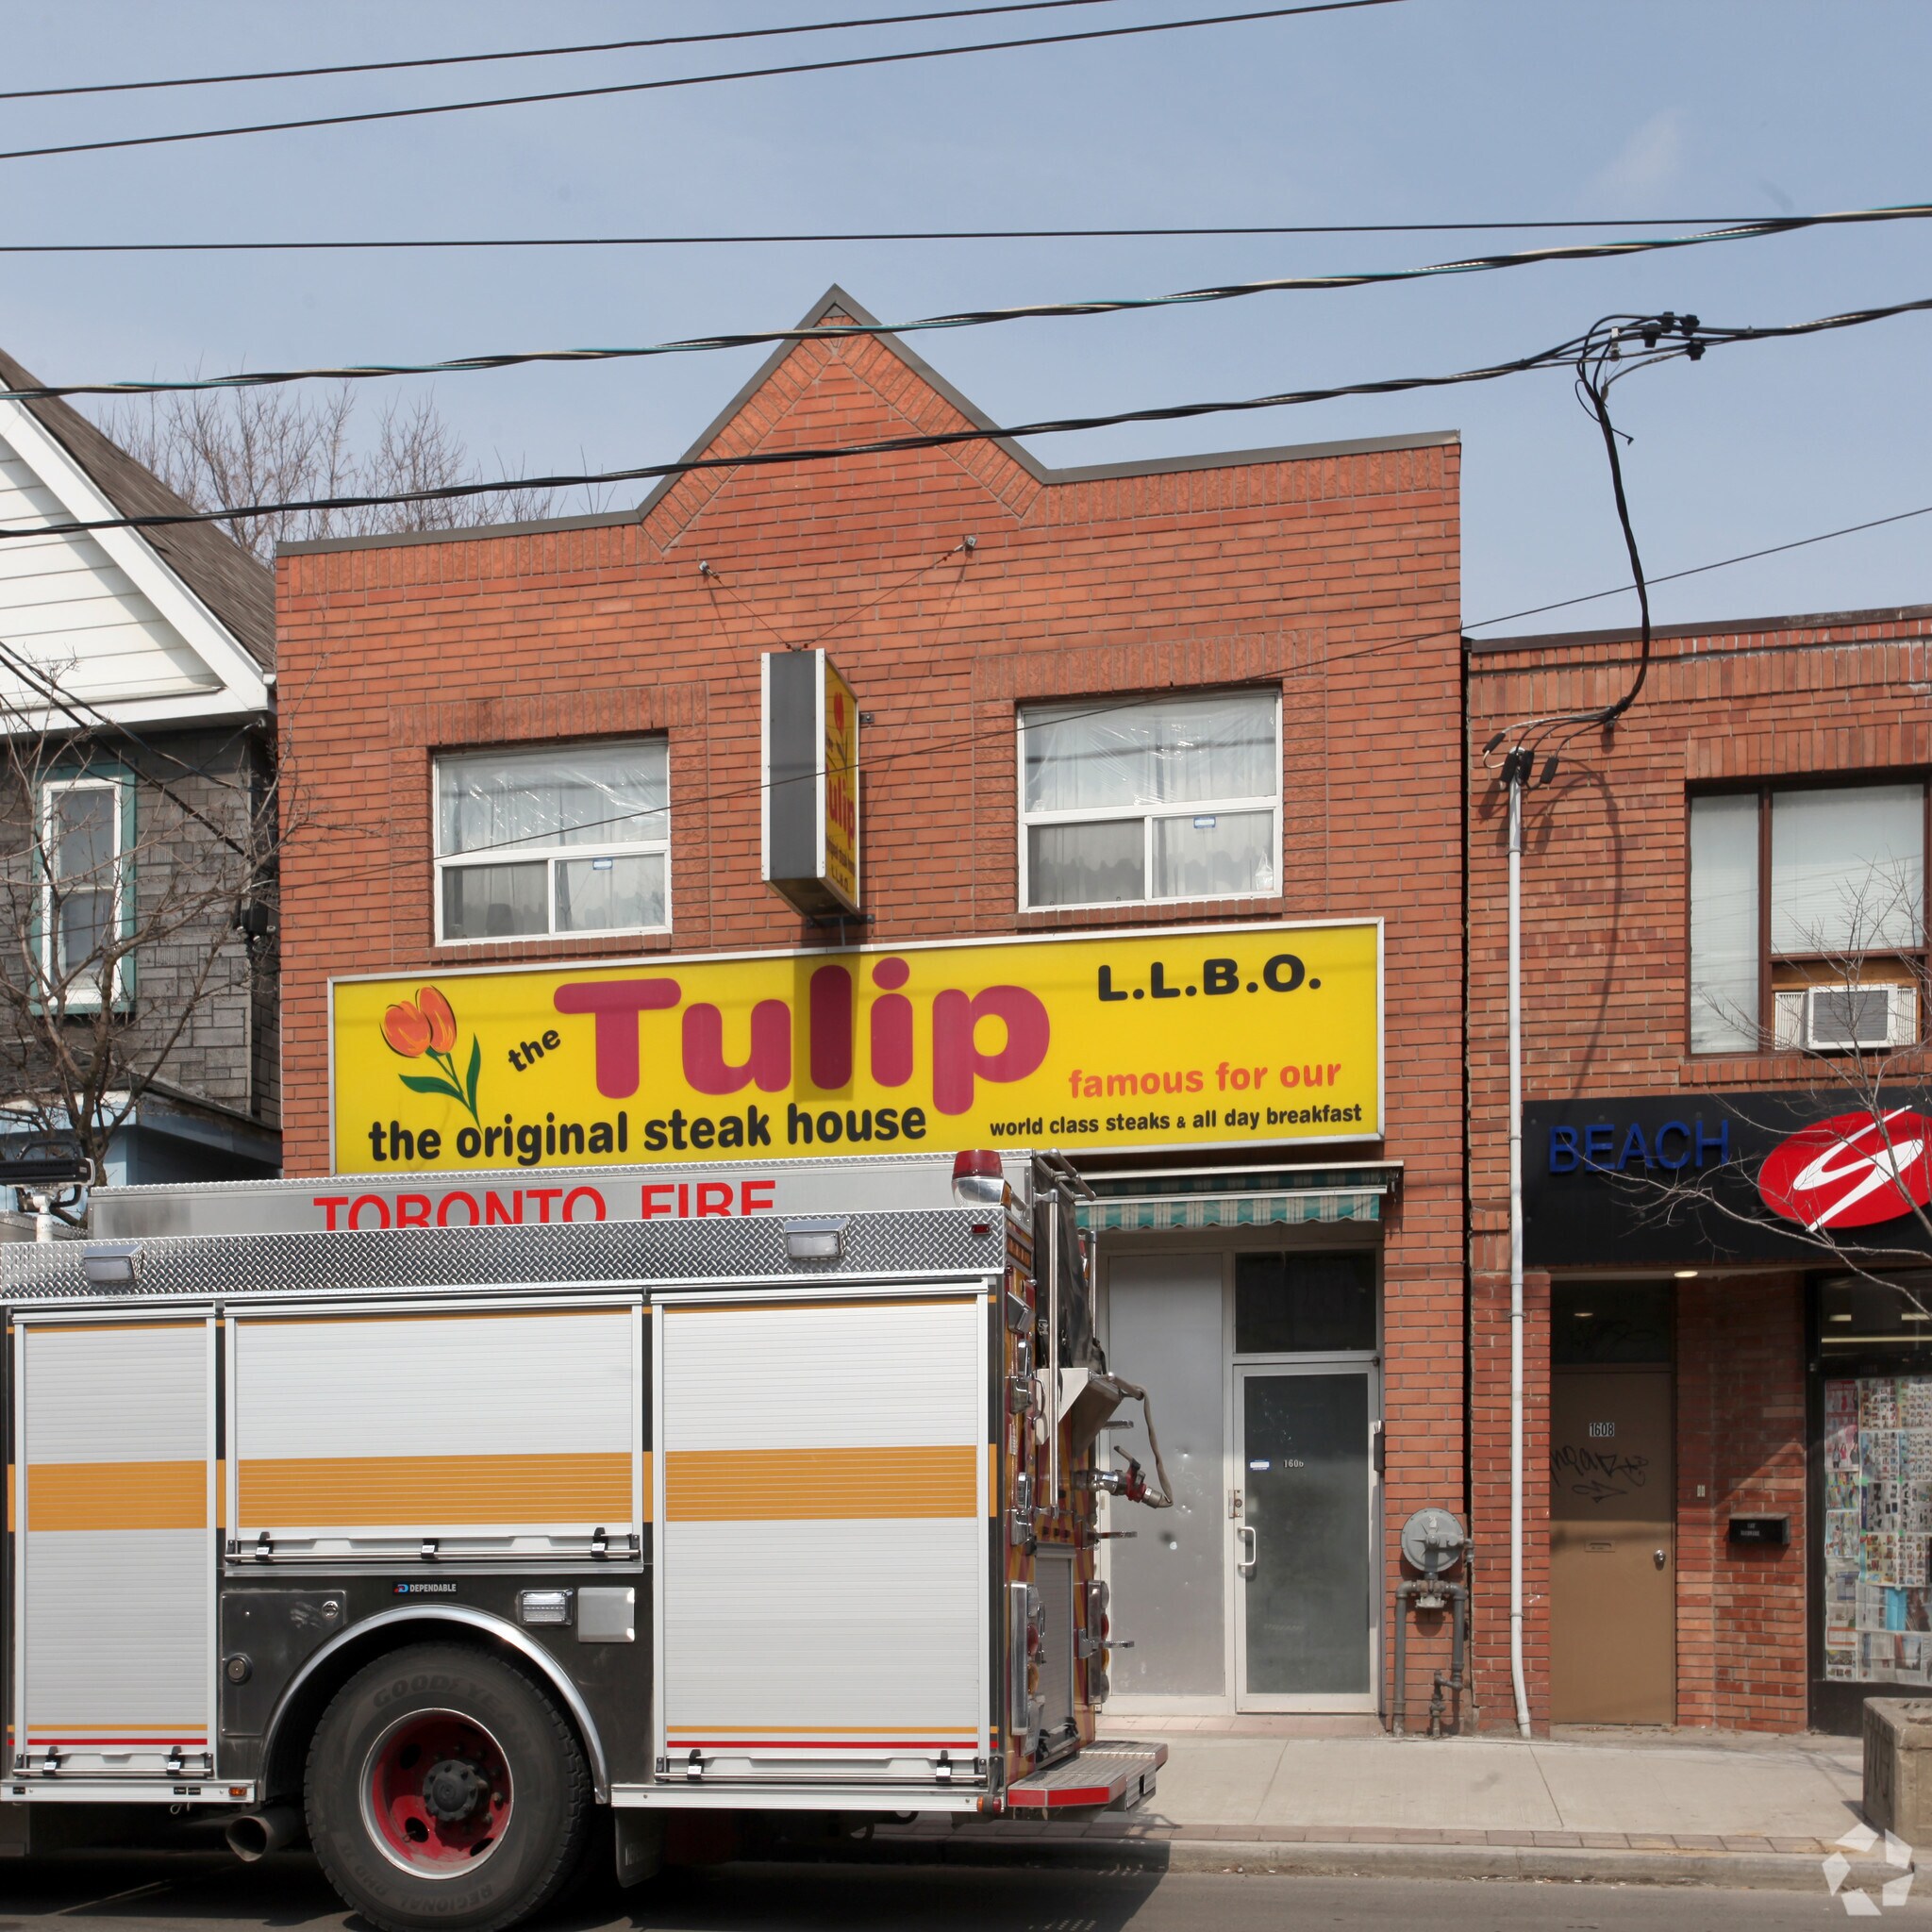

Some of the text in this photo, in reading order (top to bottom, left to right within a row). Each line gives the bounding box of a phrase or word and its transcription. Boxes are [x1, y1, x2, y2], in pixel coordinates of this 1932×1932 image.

[1098, 954, 1322, 1002] L.L.B.O.
[508, 964, 1050, 1115] the Tulip
[1068, 1061, 1342, 1099] famous for our
[368, 1103, 927, 1166] the original steak house
[990, 1103, 1363, 1137] world class steaks & all day breakfast
[1549, 1119, 1729, 1173] BEACH
[312, 1180, 776, 1231] TORONTO FIRE
[1590, 1423, 1614, 1437] 1608
[409, 1584, 457, 1592] DEPENDABLE
